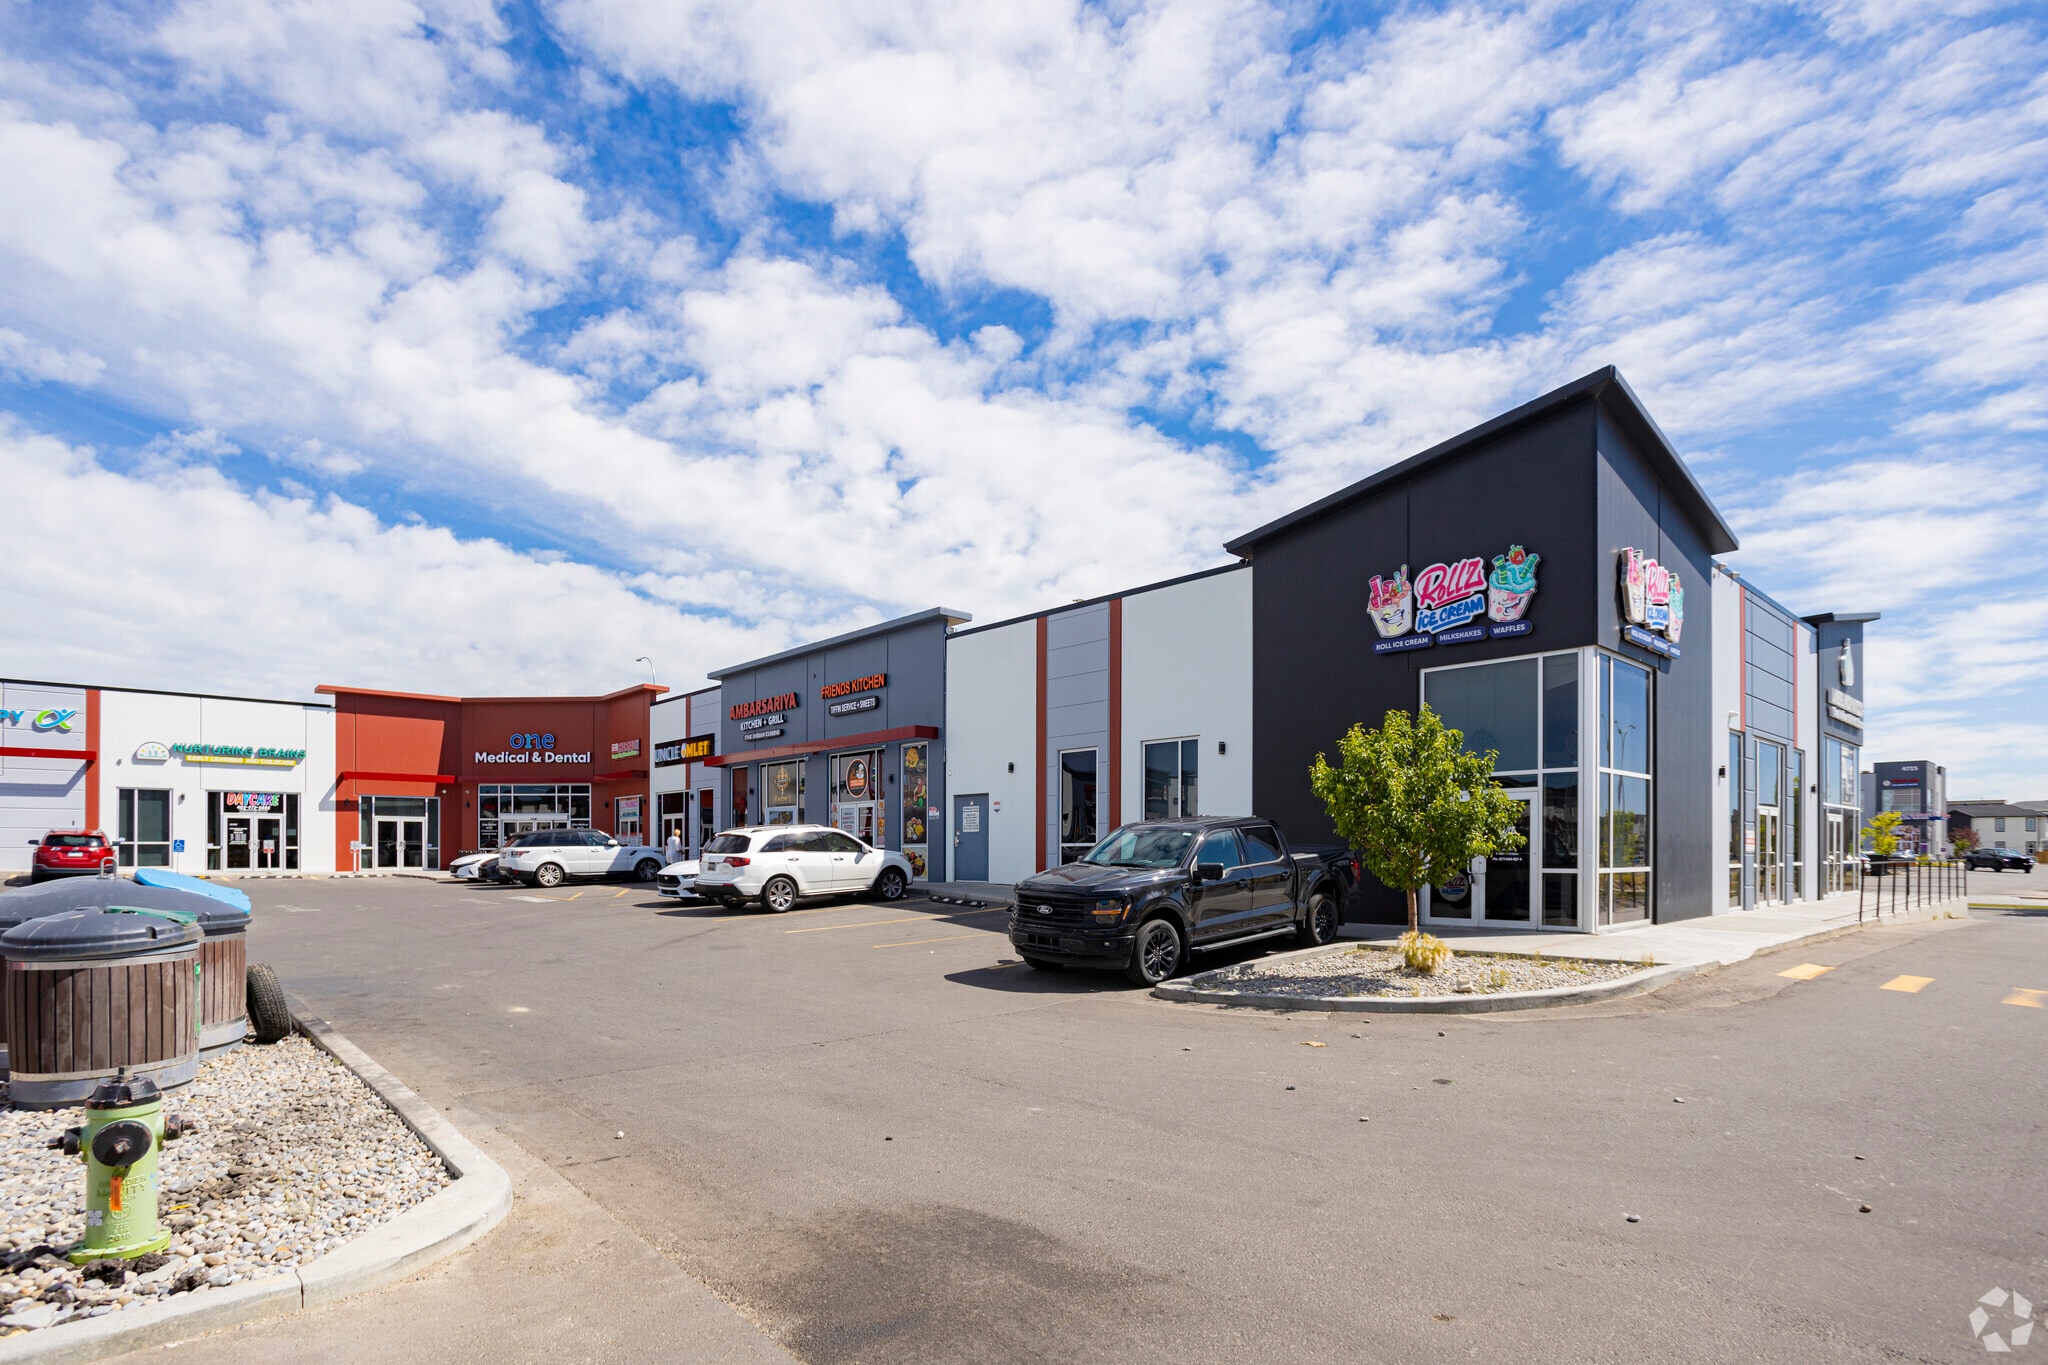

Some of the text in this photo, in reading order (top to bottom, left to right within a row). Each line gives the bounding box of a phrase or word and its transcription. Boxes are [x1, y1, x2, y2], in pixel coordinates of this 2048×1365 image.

[1439, 597, 1484, 626] CREAM
[1439, 629, 1482, 642] MILKSHAKES
[1493, 623, 1526, 635] WAFFLES
[1376, 637, 1429, 651] ROLL ICE CREAM
[821, 672, 886, 700] FRIENDS KITCHEN
[729, 691, 797, 720] AMBARSARIYA
[841, 701, 857, 712] SERVICE
[860, 698, 876, 709] SWEETS
[740, 718, 763, 731] KITCHEN
[768, 713, 784, 726] GRILL
[509, 733, 555, 750] one
[173, 742, 307, 759] NURTURING BRAINS
[475, 751, 591, 764] Medical & Dental
[655, 745, 682, 763] UNCLE
[227, 791, 280, 807] DAYCARE
